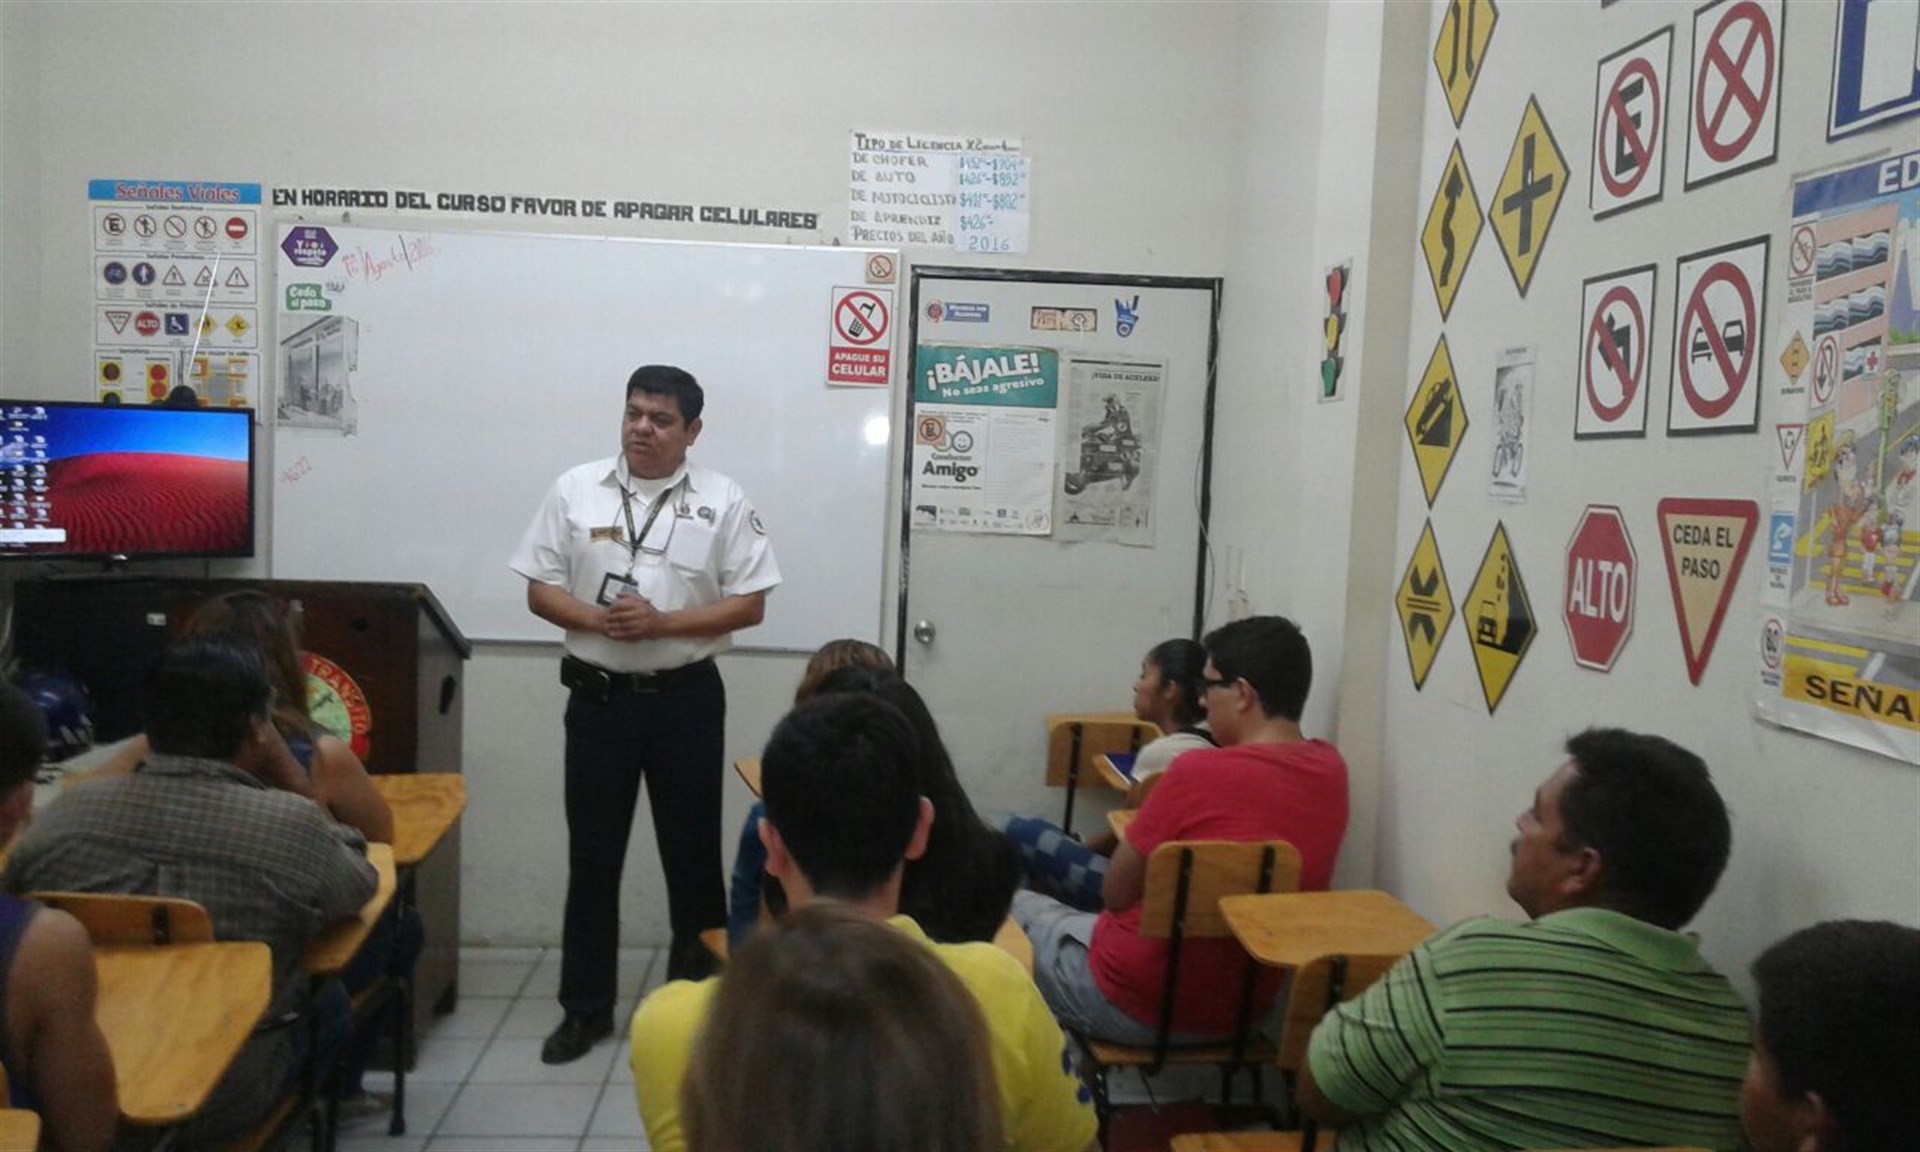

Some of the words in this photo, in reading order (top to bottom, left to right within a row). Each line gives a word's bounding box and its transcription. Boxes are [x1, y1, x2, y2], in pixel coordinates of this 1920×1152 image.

[854, 133, 886, 151] TIPO
[890, 140, 905, 150] DE
[907, 136, 962, 151] LICENCIA
[853, 152, 869, 164] DE
[872, 153, 929, 168] CHOFER
[851, 170, 867, 182] DE
[875, 171, 916, 183] AUTO
[115, 183, 183, 200] Señales
[189, 185, 240, 202] Viales
[851, 189, 865, 202] DE
[272, 188, 297, 206] EN
[302, 189, 388, 208] HORARIO
[395, 191, 431, 210] DEL
[437, 193, 506, 213] CURSO
[511, 196, 577, 217] FAVOR
[581, 200, 607, 217] DE
[613, 201, 694, 222] APAGAR
[700, 205, 818, 230] CELULARES
[851, 211, 866, 222] DE
[874, 212, 942, 226] APRENDIZ
[852, 226, 904, 242] PRECIOS
[908, 230, 928, 243] DEL
[932, 230, 955, 245] AÑO
[968, 235, 1010, 251] 2016
[136, 318, 158, 329] ALTO
[834, 352, 871, 362] APAGUE
[872, 354, 886, 363] SU
[831, 362, 887, 377] CELULAR
[926, 352, 1041, 392] ¡BÁJALE!
[942, 386, 961, 398] No
[962, 384, 990, 396] seas
[992, 375, 1045, 395] agresivo
[922, 460, 979, 483] Amigo
[1673, 524, 1712, 547] CEDA
[1716, 526, 1734, 548] EL
[1681, 556, 1721, 580] PASO
[1569, 557, 1629, 624] ALTO
